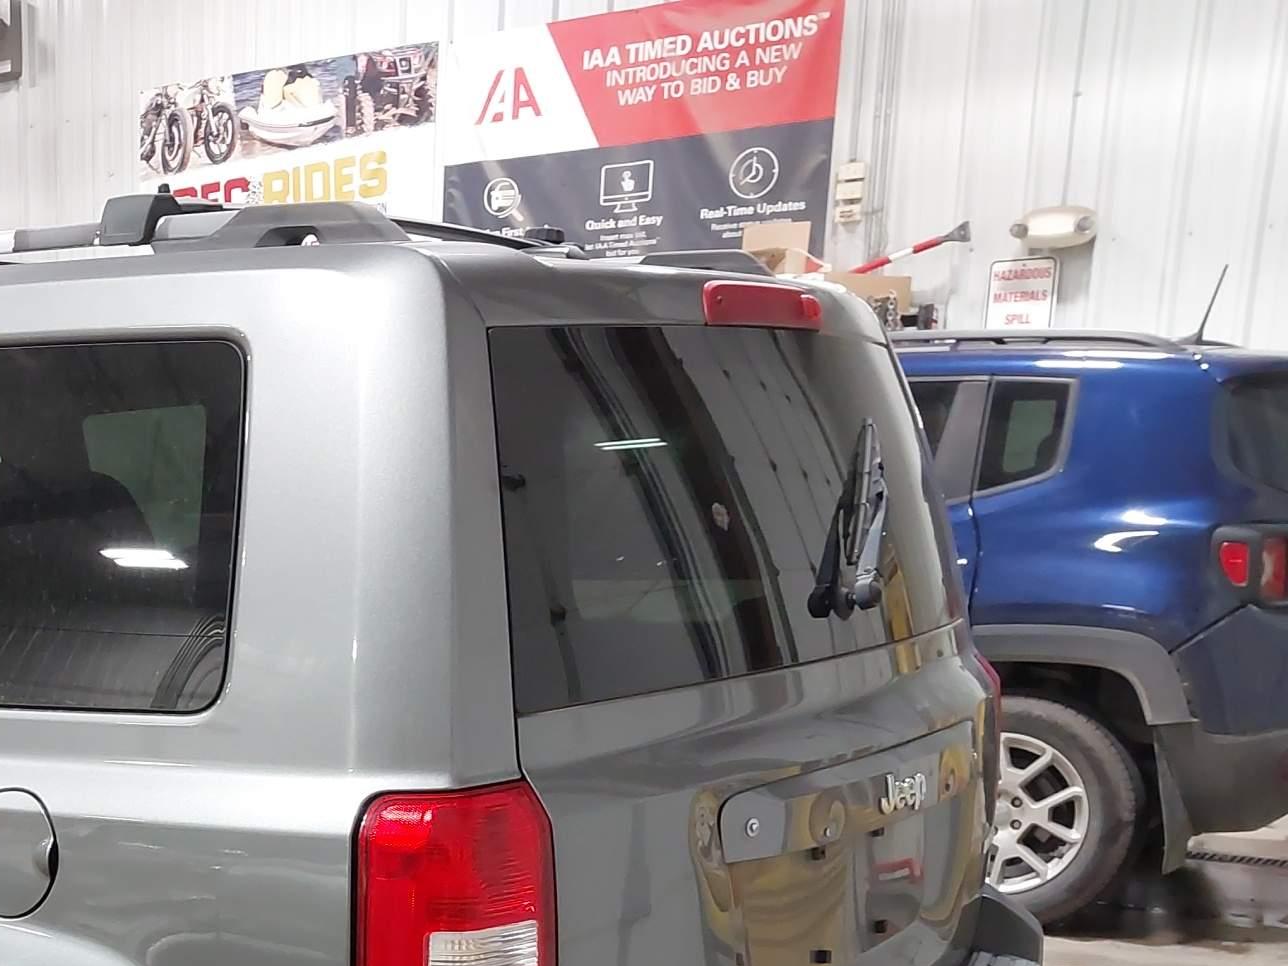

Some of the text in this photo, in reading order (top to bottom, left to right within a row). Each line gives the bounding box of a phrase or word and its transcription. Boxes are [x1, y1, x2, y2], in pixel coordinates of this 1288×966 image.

[583, 46, 622, 70] IAA
[625, 35, 692, 62] TIMED
[606, 42, 803, 87] INTRODUCING A NEW
[617, 66, 788, 106] WAY TO BID & BUY
[263, 151, 388, 204] RIDES
[585, 213, 664, 231] Quick and Easy
[699, 201, 807, 220] Real-Time Updates
[993, 267, 1052, 281] HAZARDOUS
[992, 289, 1048, 303] MATERIALS
[1004, 313, 1030, 325] SPILL
[880, 773, 927, 815] Jeep
